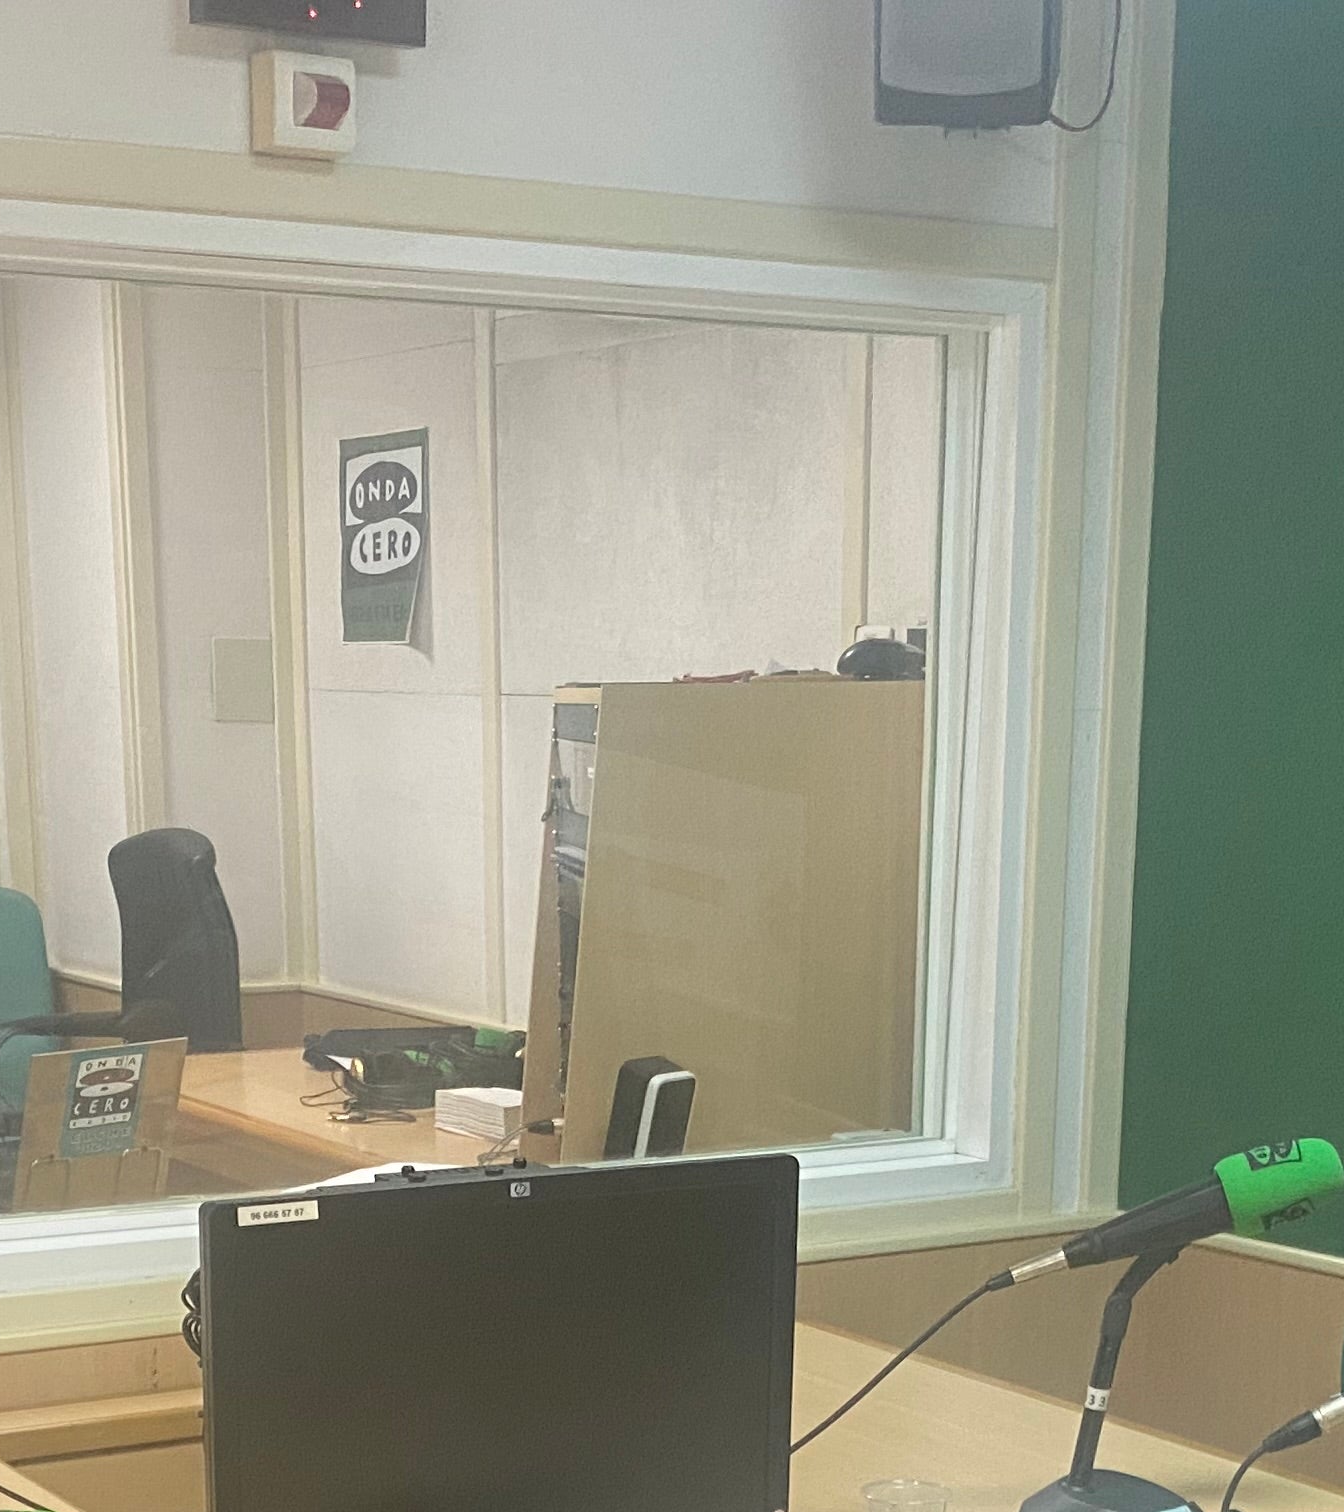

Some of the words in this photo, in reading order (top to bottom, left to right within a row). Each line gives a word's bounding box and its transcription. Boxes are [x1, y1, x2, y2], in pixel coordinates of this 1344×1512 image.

[355, 476, 411, 509] ONDA
[358, 529, 412, 564] CERO
[85, 1057, 136, 1071] ONDA
[73, 1097, 130, 1116] CERO
[1088, 1394, 1096, 1406] 3
